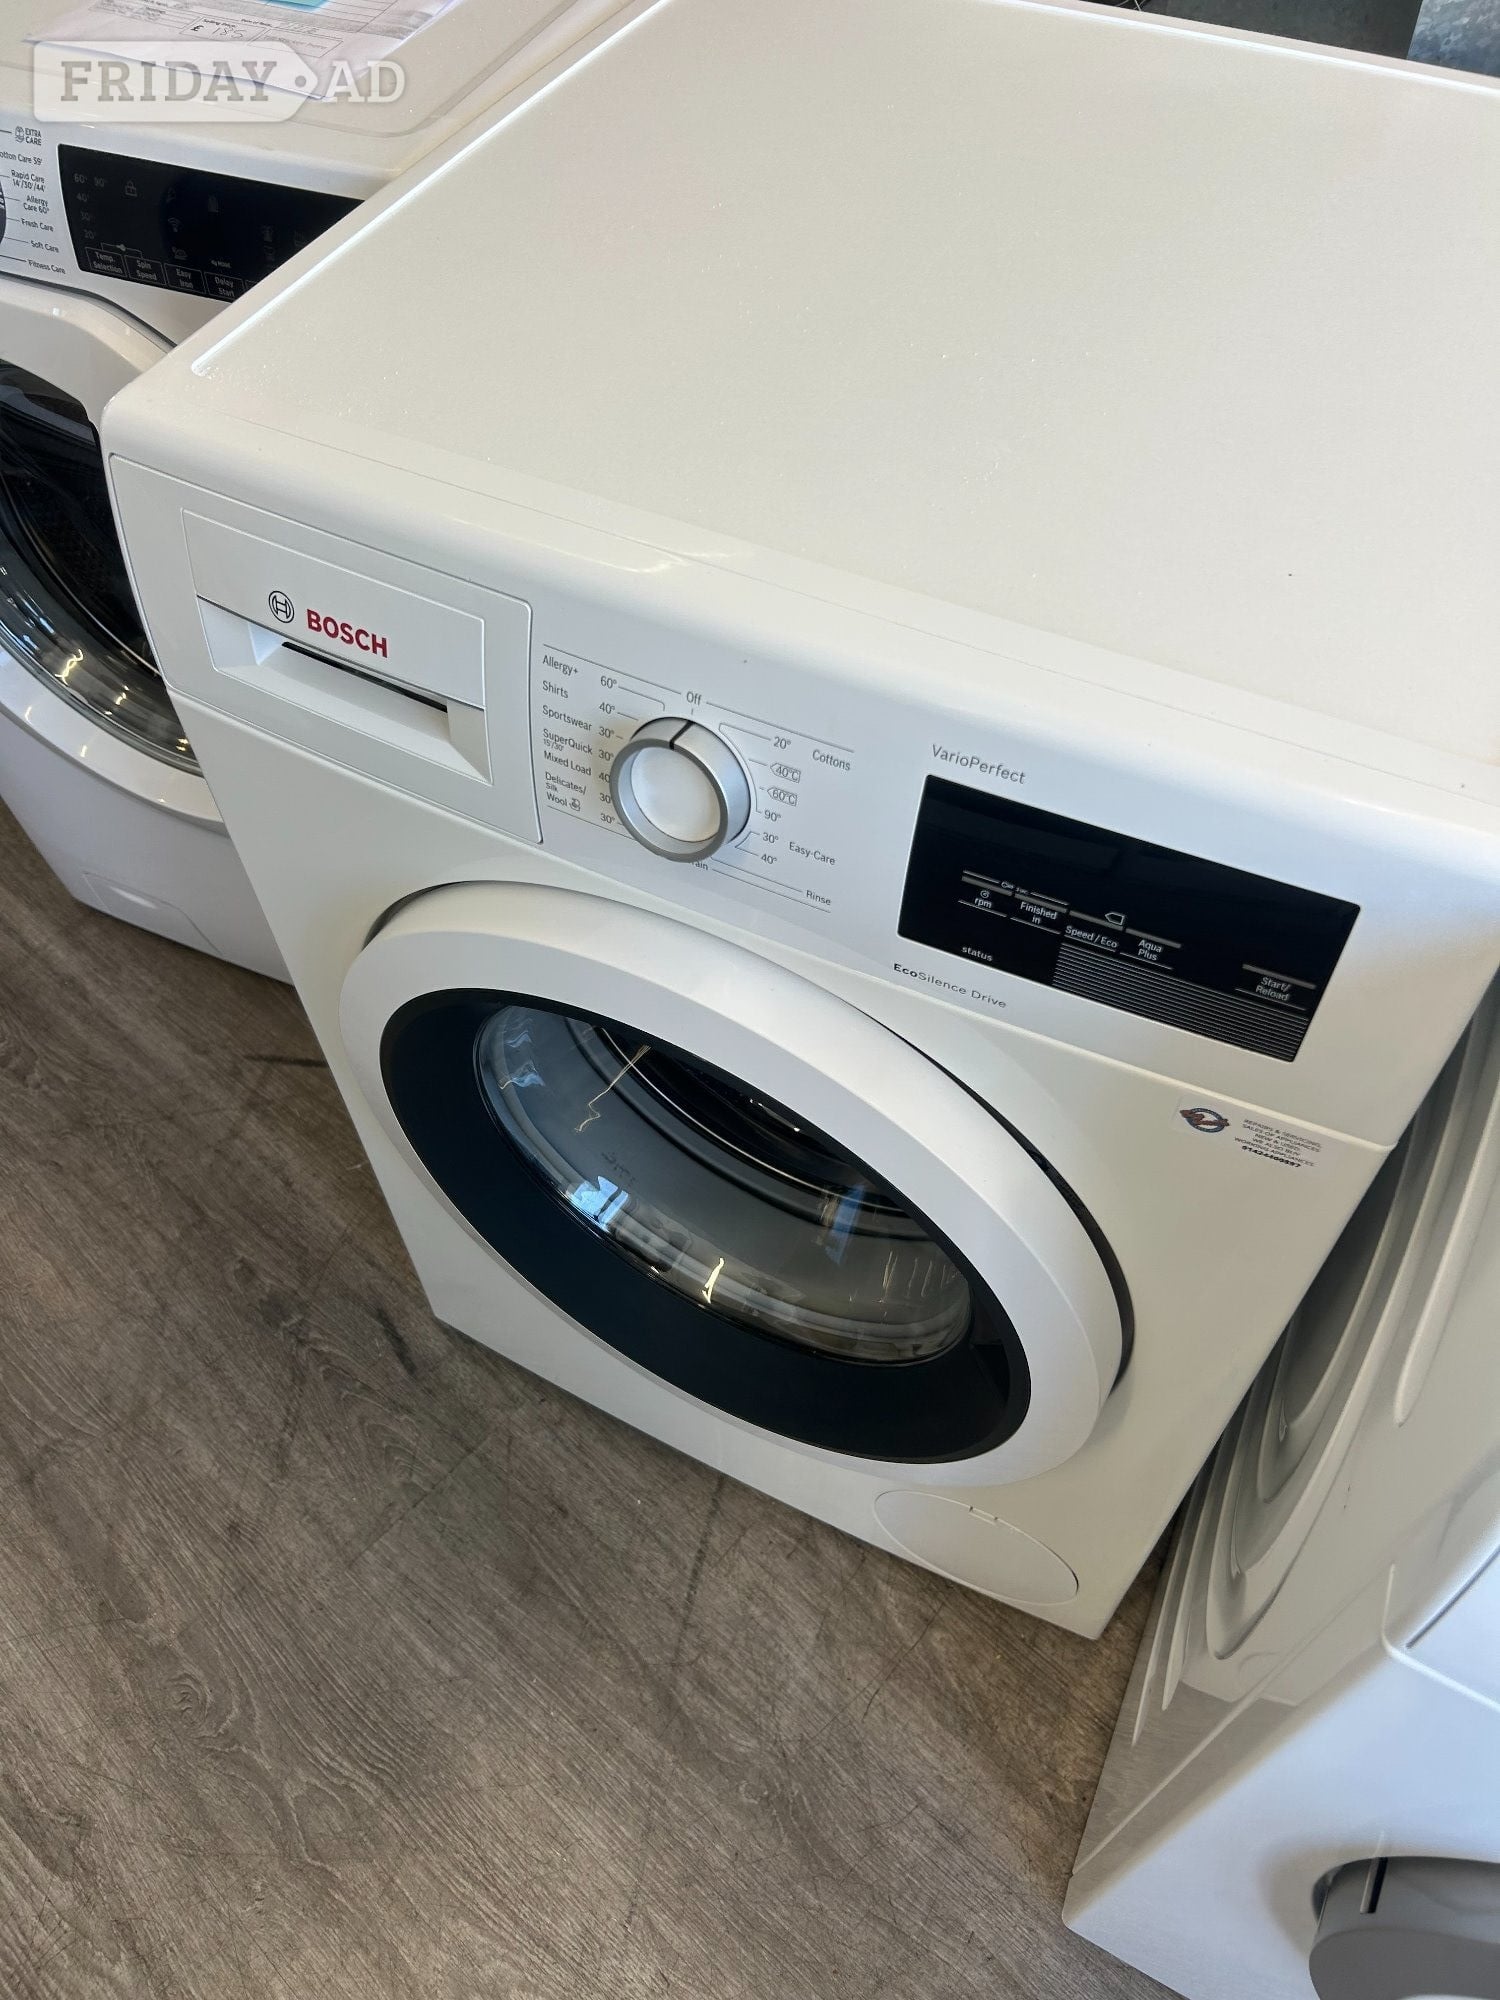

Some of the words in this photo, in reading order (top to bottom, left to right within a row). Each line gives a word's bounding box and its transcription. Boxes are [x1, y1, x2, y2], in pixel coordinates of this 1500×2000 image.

[25, 127, 42, 138] EXTRA
[25, 136, 42, 146] CARE
[18, 153, 32, 164] Care
[11, 169, 30, 181] Rapid
[31, 173, 45, 184] Care
[23, 202, 38, 212] Care
[27, 195, 49, 207] Allergy
[21, 217, 39, 229] Fresh
[39, 222, 54, 233] Care
[31, 240, 44, 250] Soft
[44, 243, 60, 254] Care
[28, 259, 51, 271] Fitness
[51, 264, 66, 275] Care
[214, 275, 235, 289] Delay
[306, 608, 389, 659] BOSCH
[542, 654, 579, 677] Allergy+
[542, 680, 569, 699] Shirts
[600, 675, 618, 690] 60°
[686, 690, 702, 706] Off
[599, 701, 616, 715] 40°
[542, 704, 593, 732] Sportswear
[598, 726, 615, 740] 30°
[543, 728, 593, 756] SuperQuick
[773, 736, 792, 750] 20°
[544, 749, 569, 768] Mixed
[570, 760, 592, 776] Load
[598, 749, 615, 762] 30°
[812, 749, 851, 771] Cottons
[932, 744, 1026, 785] VarioPerfect
[776, 764, 800, 782] 40°C
[545, 771, 587, 796] Delicates/
[545, 782, 558, 793] Silk
[546, 791, 568, 807] Wool
[772, 788, 797, 806] 60°C
[764, 809, 782, 822] 90°
[762, 831, 780, 844] 30°
[760, 853, 778, 865] 40°
[789, 841, 836, 866] Easy-Care
[806, 889, 832, 906] Rinse
[974, 897, 993, 909] rpm
[1020, 901, 1058, 920] Finished
[1031, 914, 1041, 925] in
[1064, 925, 1095, 943] Speed
[1100, 936, 1118, 949] Eco
[962, 945, 993, 962] status
[1137, 939, 1163, 953] Aqua
[1137, 948, 1158, 962] Plus
[893, 963, 967, 995] EcoSilence
[971, 990, 1007, 1008] Drive
[1255, 984, 1289, 1001] Reload
[1261, 976, 1291, 993] Start/
